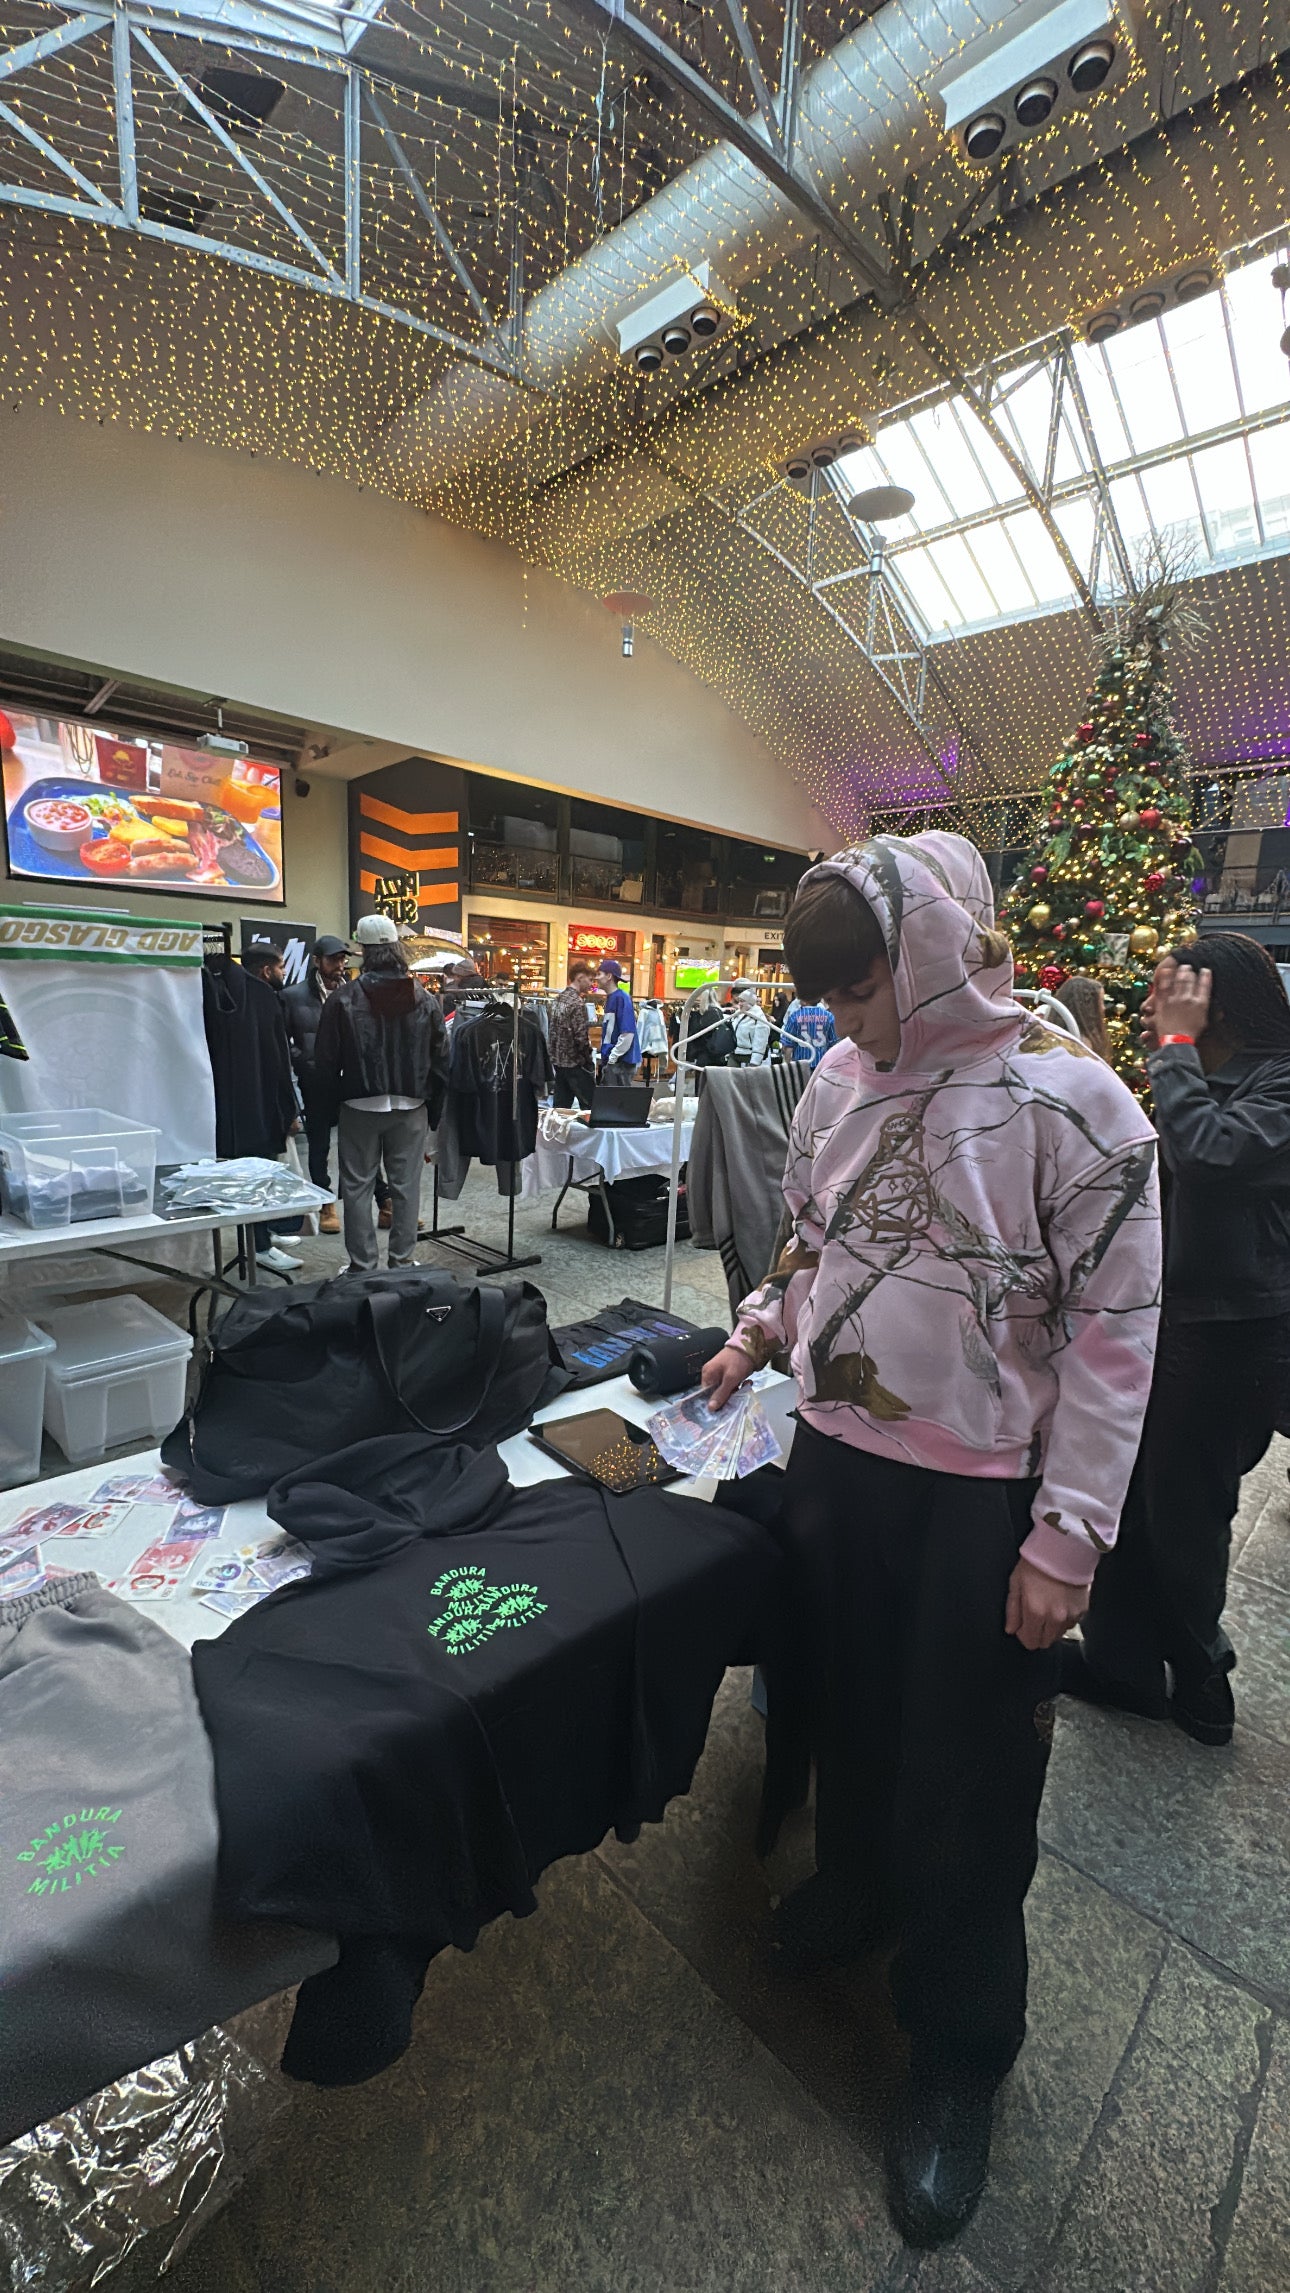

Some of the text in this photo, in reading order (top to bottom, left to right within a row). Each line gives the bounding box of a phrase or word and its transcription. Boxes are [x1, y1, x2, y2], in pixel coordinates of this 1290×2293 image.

[137, 931, 200, 951] AGD
[764, 932, 785, 940] EXIT
[430, 1566, 486, 1595] BANDURA
[494, 1603, 548, 1628] MILITIA
[447, 1624, 497, 1655] MILITIA
[16, 1806, 122, 1861] BANDURA
[26, 1846, 126, 1896] MILITIA
